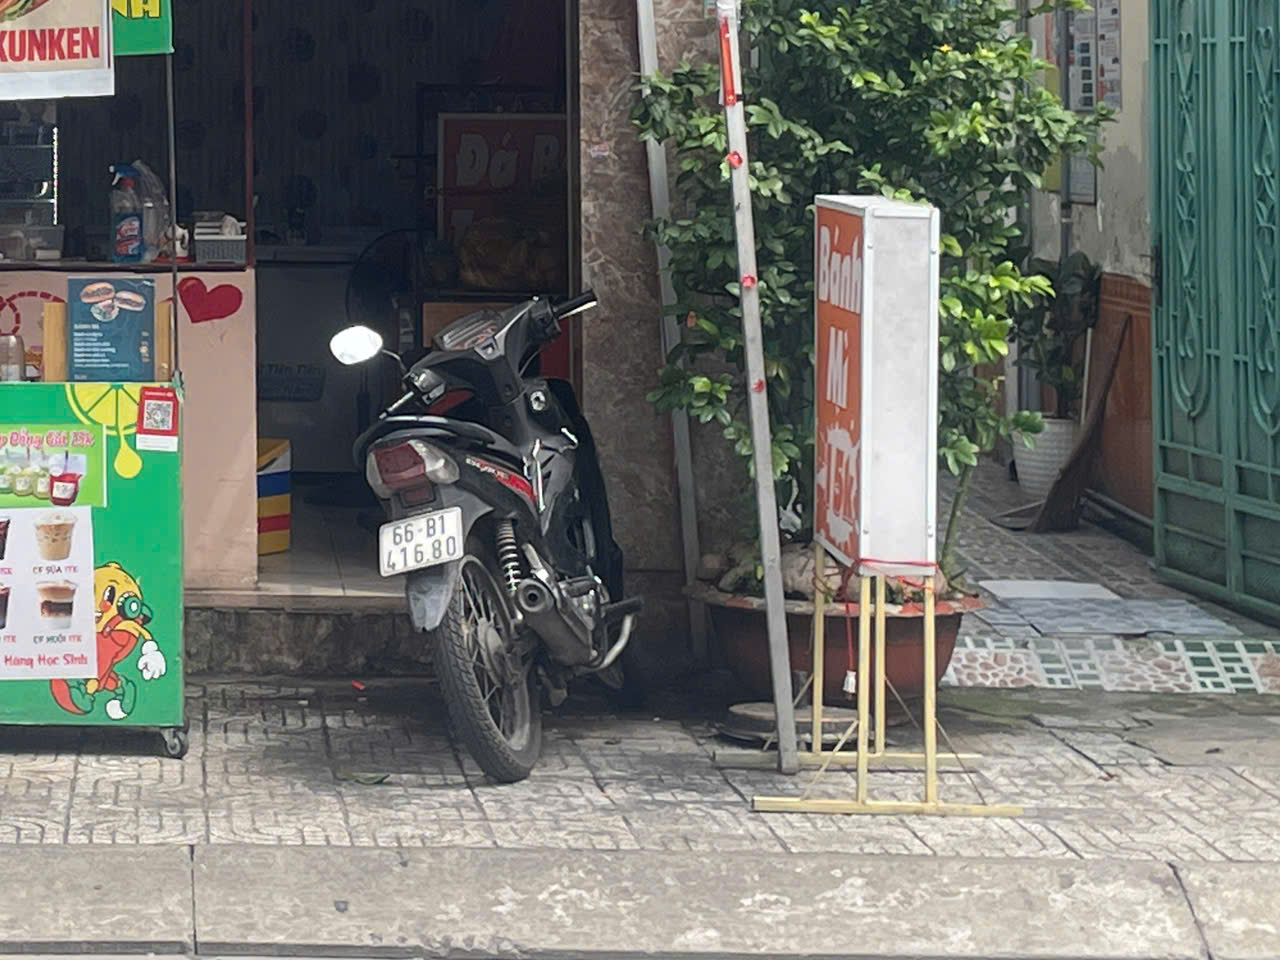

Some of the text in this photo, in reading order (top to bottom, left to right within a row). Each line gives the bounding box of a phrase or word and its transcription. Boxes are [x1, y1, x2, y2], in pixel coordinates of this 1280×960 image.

[819, 225, 861, 314] Bánh
[392, 515, 446, 546] 66-B1
[387, 536, 456, 570] 416.80
